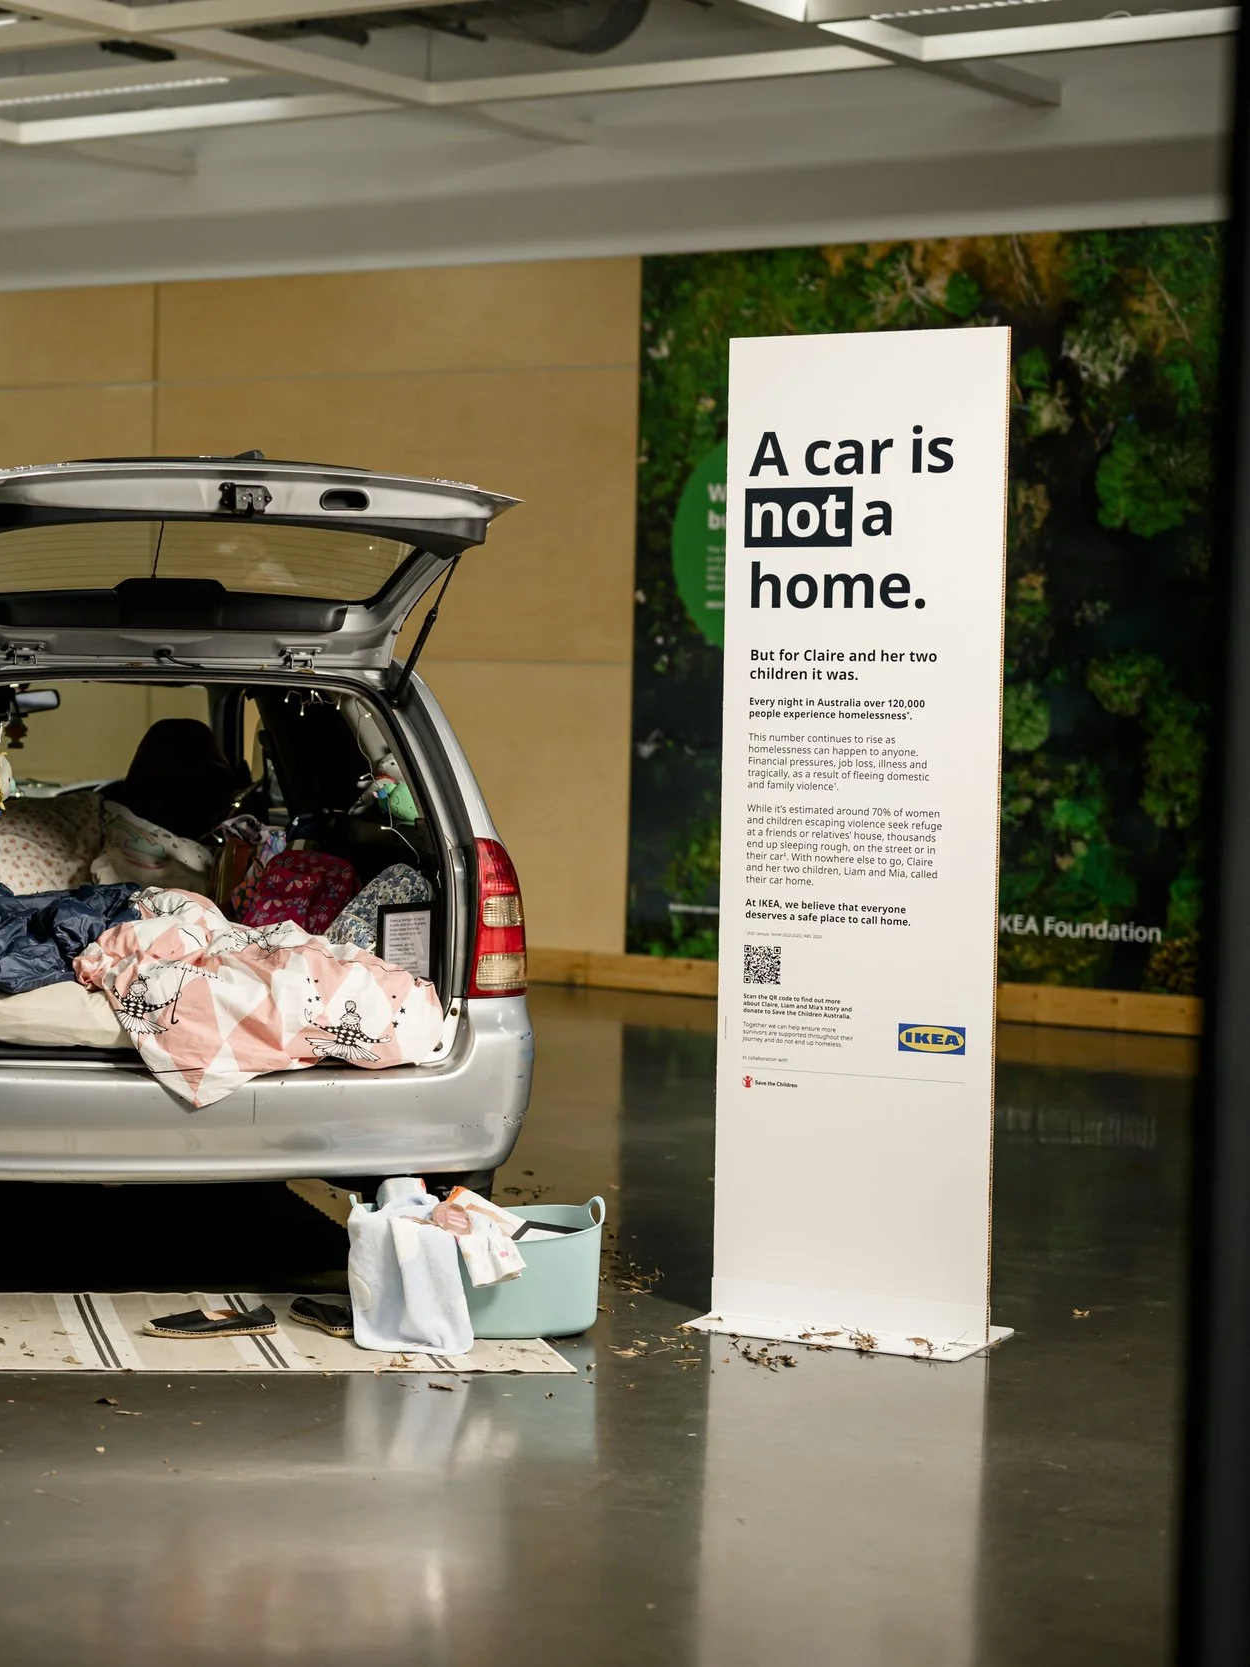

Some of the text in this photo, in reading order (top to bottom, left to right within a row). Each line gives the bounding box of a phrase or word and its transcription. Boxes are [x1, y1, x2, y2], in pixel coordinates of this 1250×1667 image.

[749, 425, 954, 476] A car is
[752, 494, 845, 538] not
[862, 500, 892, 536] a
[751, 562, 925, 608] home.
[751, 649, 937, 662] But for Claire and her two
[750, 668, 858, 680] children it was.
[750, 698, 775, 708] Every
[778, 698, 803, 708] night
[806, 698, 814, 706] in
[817, 699, 861, 707] Australia
[888, 700, 925, 709] 120,000
[749, 709, 780, 719] people
[784, 710, 836, 720] experience
[749, 733, 766, 741] This
[769, 733, 805, 742] number
[807, 734, 851, 743] continues
[854, 735, 863, 743] to
[866, 735, 883, 743] rise
[749, 745, 811, 754] homelessness
[833, 746, 867, 757] happen
[870, 747, 879, 755] to
[882, 749, 918, 758] anyone.
[749, 757, 927, 769] Financial pressures, job loss, illness and
[748, 769, 790, 780] tragically,
[814, 770, 838, 779] result
[842, 771, 850, 779] of
[853, 771, 884, 782] fleeing
[887, 772, 929, 781] domestic
[748, 780, 764, 789] and
[767, 781, 794, 792] family
[747, 804, 772, 813] While
[789, 805, 834, 815] estimated
[837, 807, 869, 816] around
[872, 808, 891, 816] 70%
[894, 808, 903, 817] of
[747, 816, 942, 832] and children escaping violence seek refuge
[746, 875, 767, 884] their
[786, 876, 814, 885] home.
[746, 898, 756, 907] At
[759, 899, 782, 909] IKEA,
[802, 901, 835, 910] believe
[838, 903, 858, 911] that
[861, 905, 906, 915] everyone
[746, 910, 787, 920] deserves
[798, 913, 817, 921] safe
[821, 914, 845, 925] place
[848, 915, 858, 923] to
[861, 916, 877, 924] call
[881, 917, 910, 926] home.
[1000, 912, 1162, 944] KEA Foundation
[905, 1032, 960, 1046] IKEA
